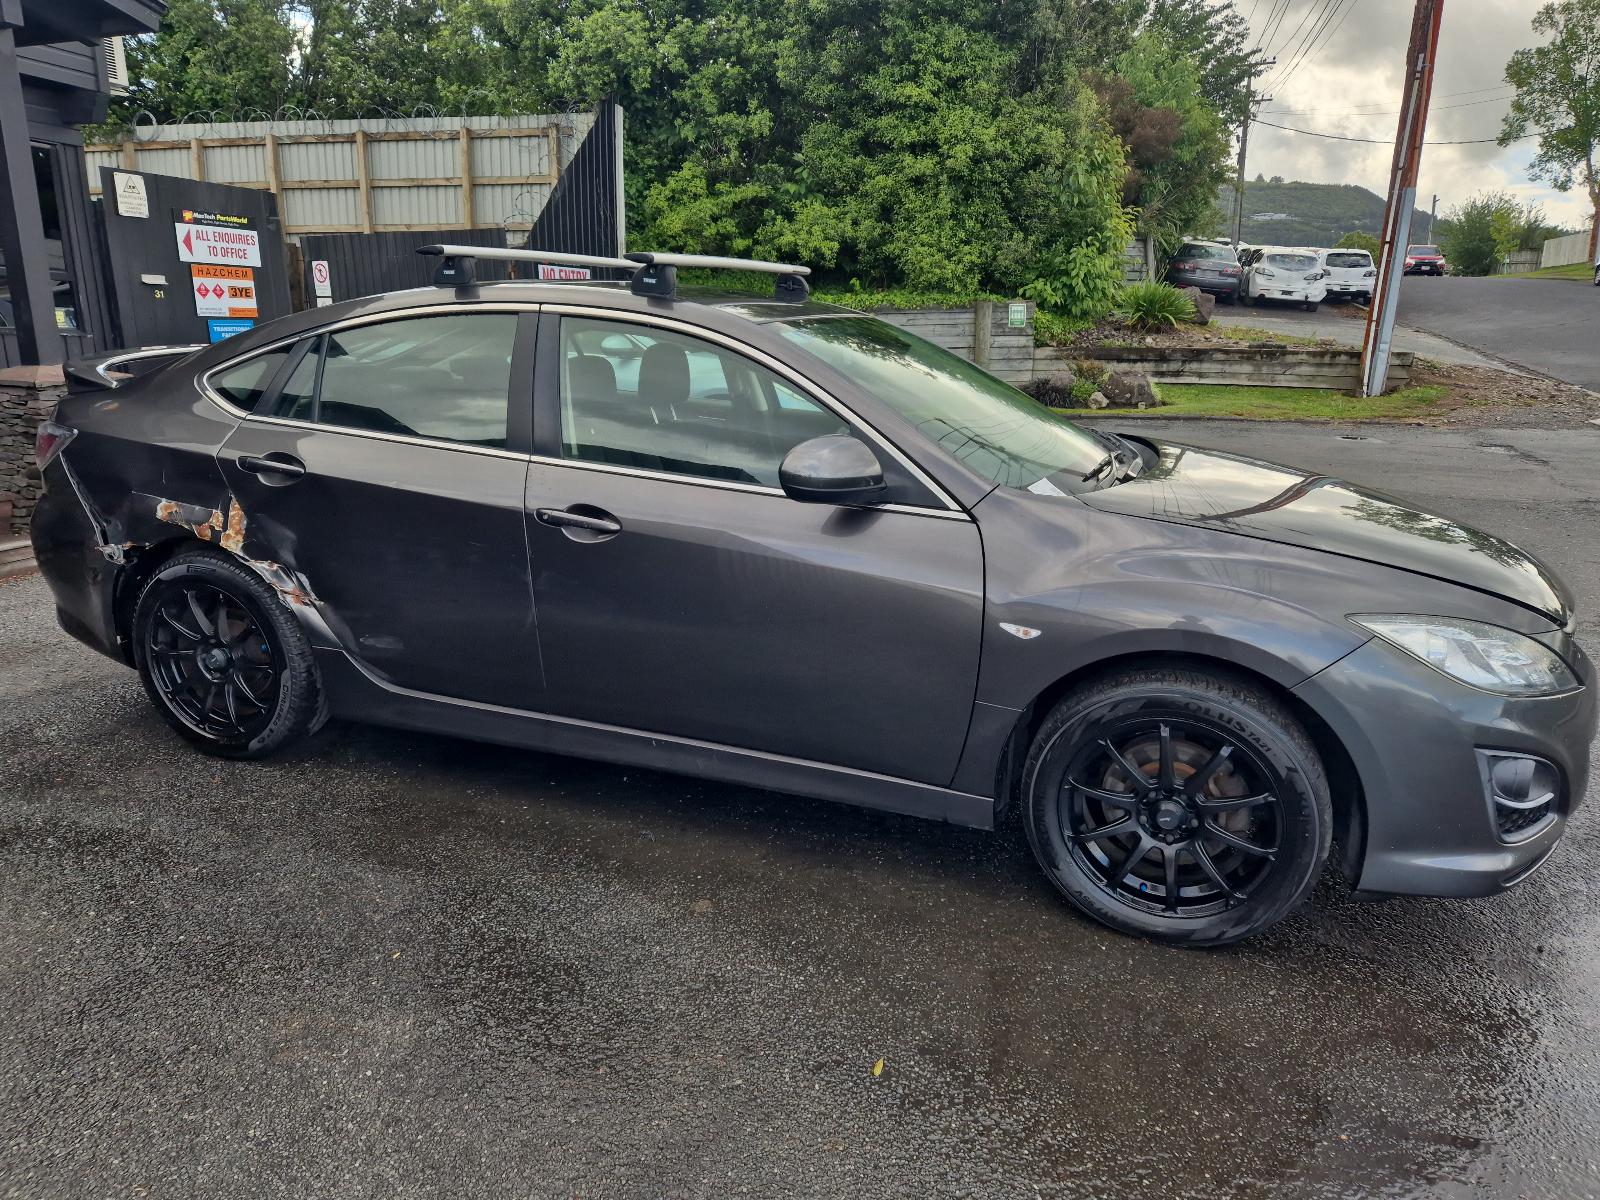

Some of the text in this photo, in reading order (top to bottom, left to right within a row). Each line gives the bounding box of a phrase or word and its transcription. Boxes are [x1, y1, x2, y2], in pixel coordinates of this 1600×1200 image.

[216, 214, 248, 223] PartsWorld
[196, 230, 256, 246] ALL ENQUIRIES
[208, 245, 248, 259] TO OFFICE
[197, 267, 248, 278] HAZCHEM
[542, 267, 556, 279] NO
[155, 290, 164, 298] 31
[231, 287, 251, 297] 3YE
